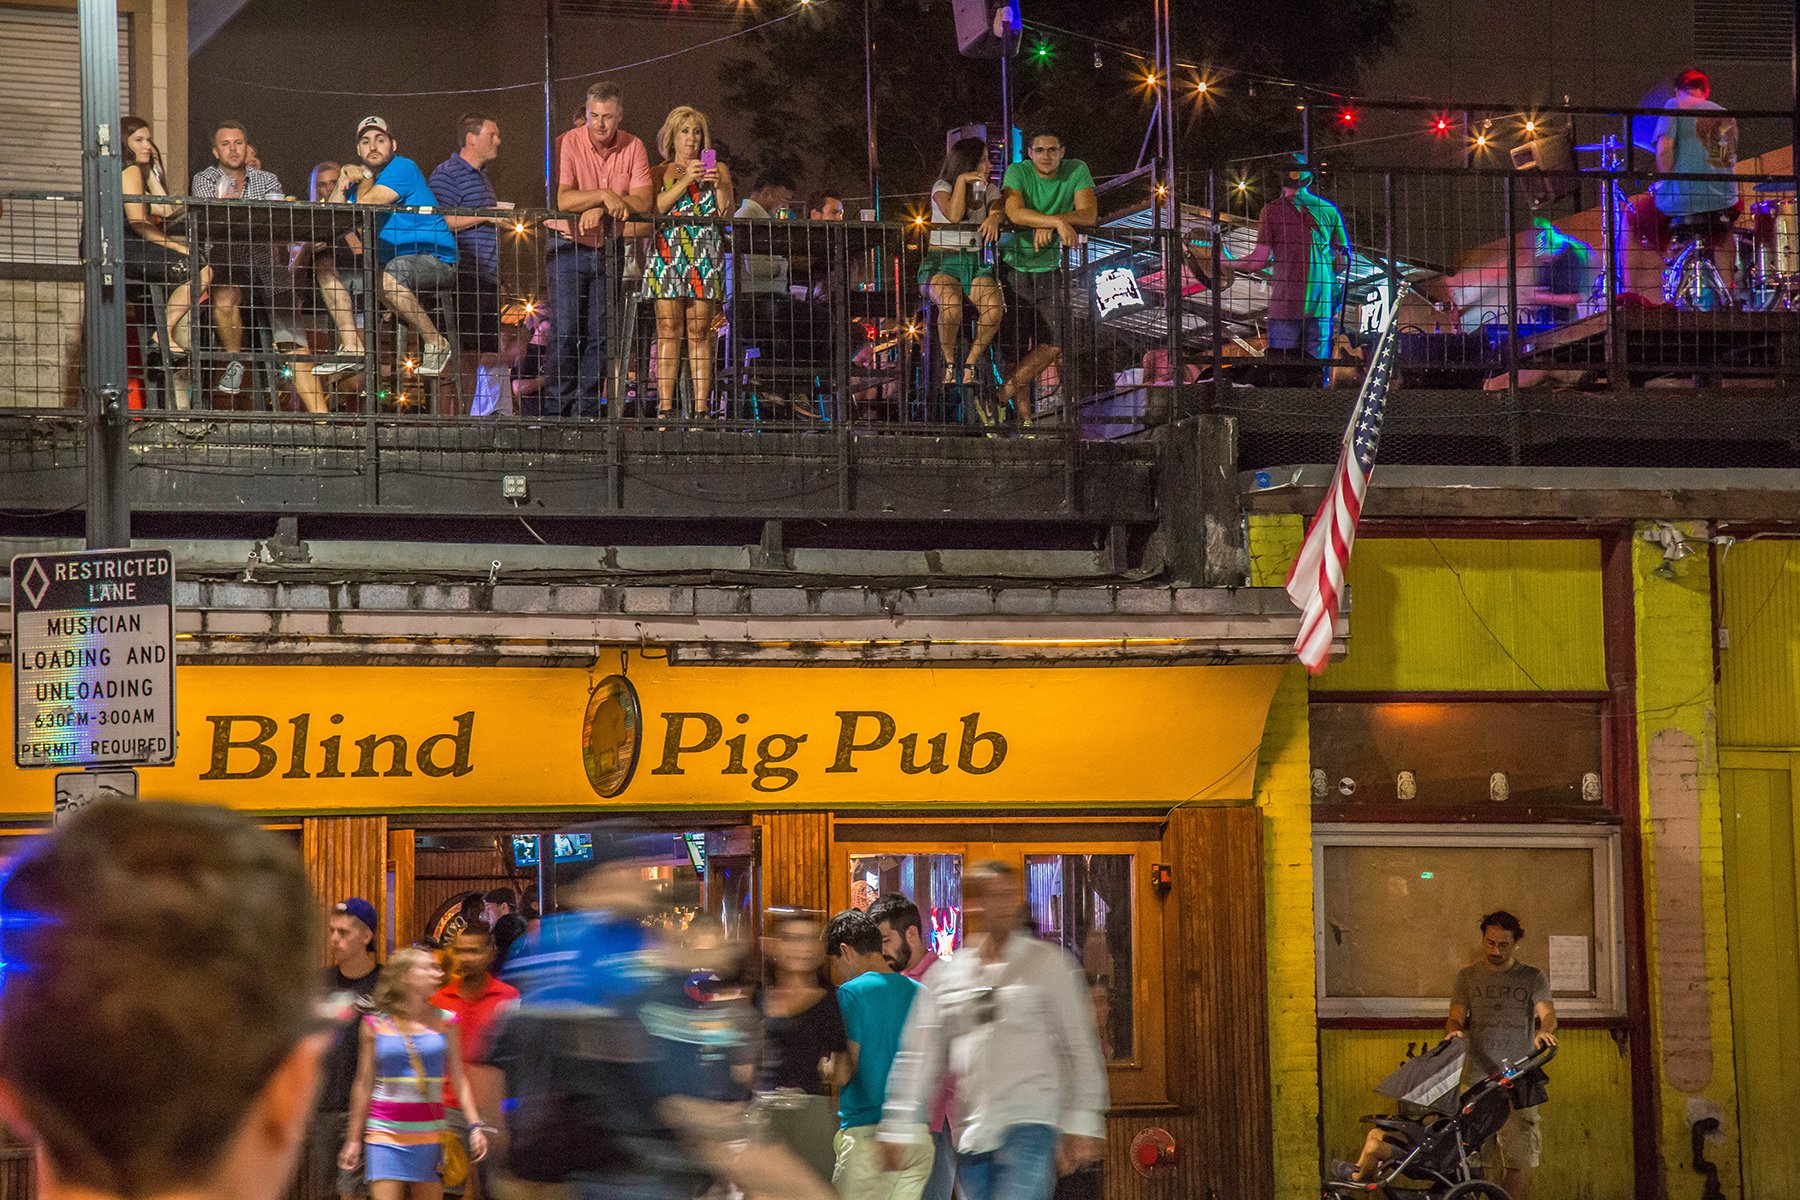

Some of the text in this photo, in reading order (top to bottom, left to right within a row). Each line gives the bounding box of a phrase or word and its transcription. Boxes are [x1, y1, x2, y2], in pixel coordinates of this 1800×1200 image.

[55, 558, 169, 581] RESTRICTED
[89, 582, 136, 602] LANE
[47, 614, 141, 636] MUSICIAN
[21, 645, 166, 670] LOADING AND
[36, 678, 153, 701] UNLOADING
[21, 738, 167, 758] PERMIT REQUIRED
[199, 711, 1008, 792] Blind Pig Pub
[1472, 985, 1529, 1002] AERO
